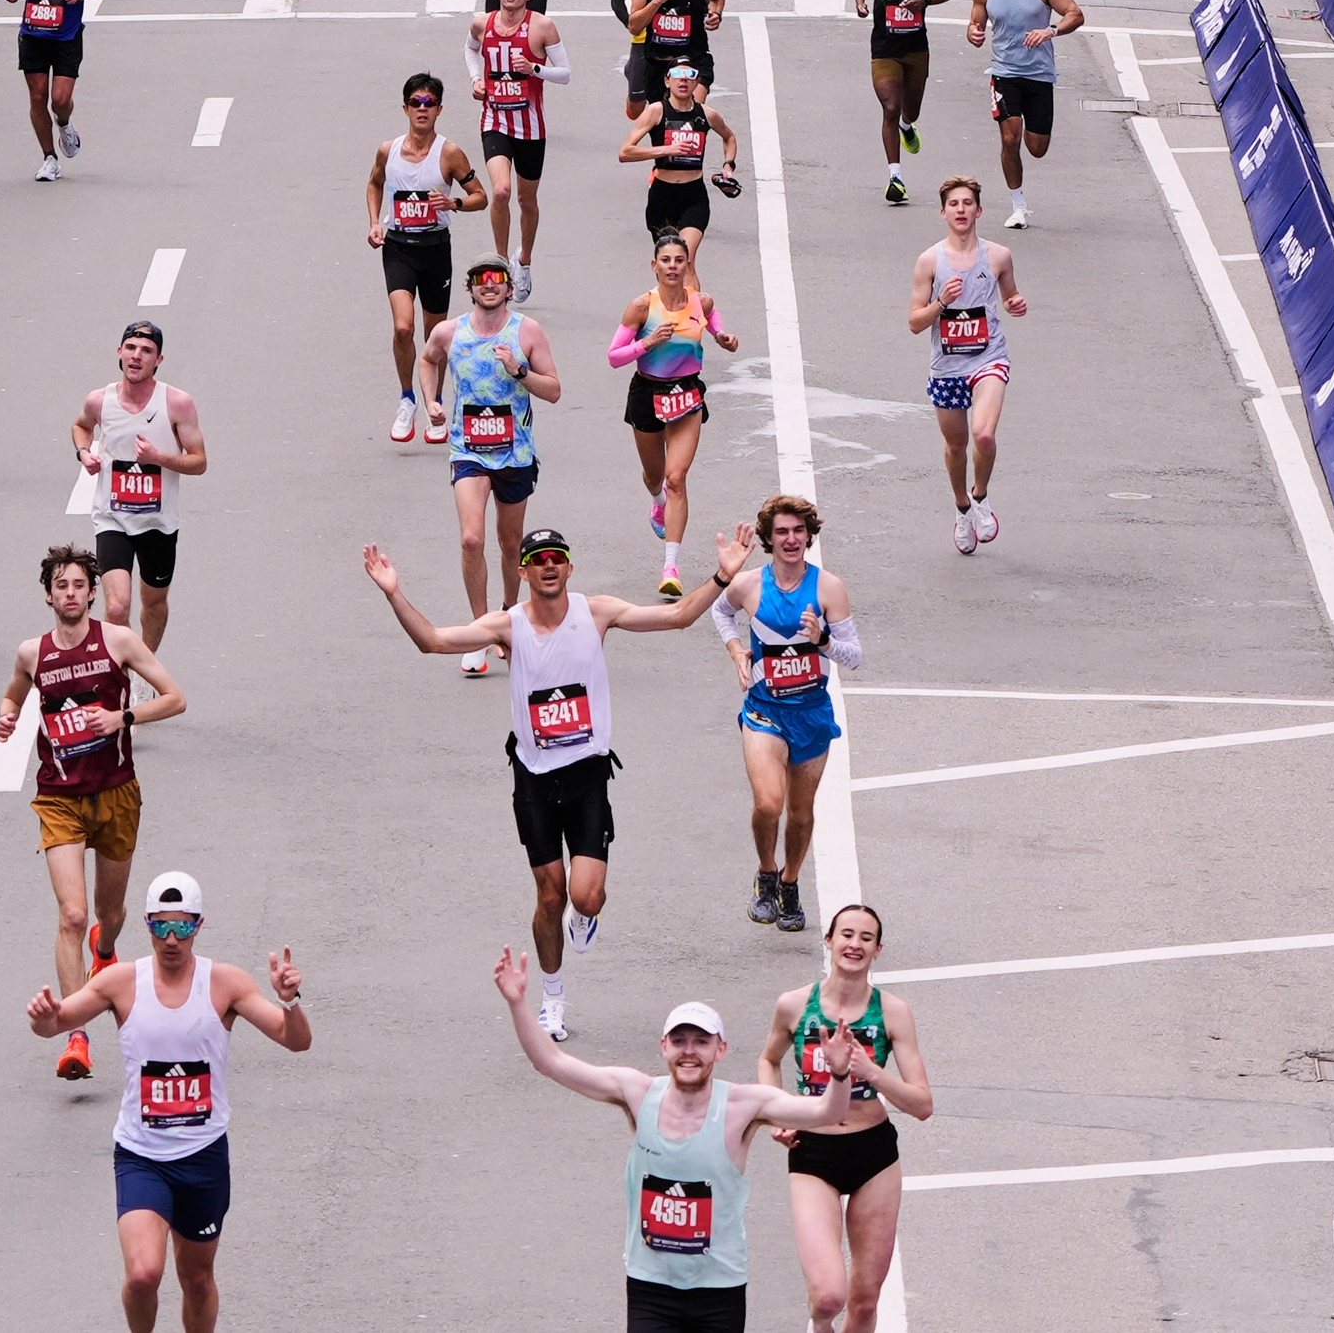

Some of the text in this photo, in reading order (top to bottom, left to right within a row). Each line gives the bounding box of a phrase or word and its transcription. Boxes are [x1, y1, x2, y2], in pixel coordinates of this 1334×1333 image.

[31, 5, 57, 20] 2684
[657, 16, 685, 31] 4699
[493, 82, 521, 97] 2165
[399, 202, 430, 218] 3647
[947, 318, 980, 338] 2707
[469, 418, 505, 436] 3968
[119, 475, 153, 494] 1410
[40, 659, 111, 686] BOSTON COLLEGE
[771, 657, 811, 680] 2504
[538, 700, 579, 727] 5241
[151, 1078, 201, 1104] 6114
[650, 1196, 697, 1227] 4351
